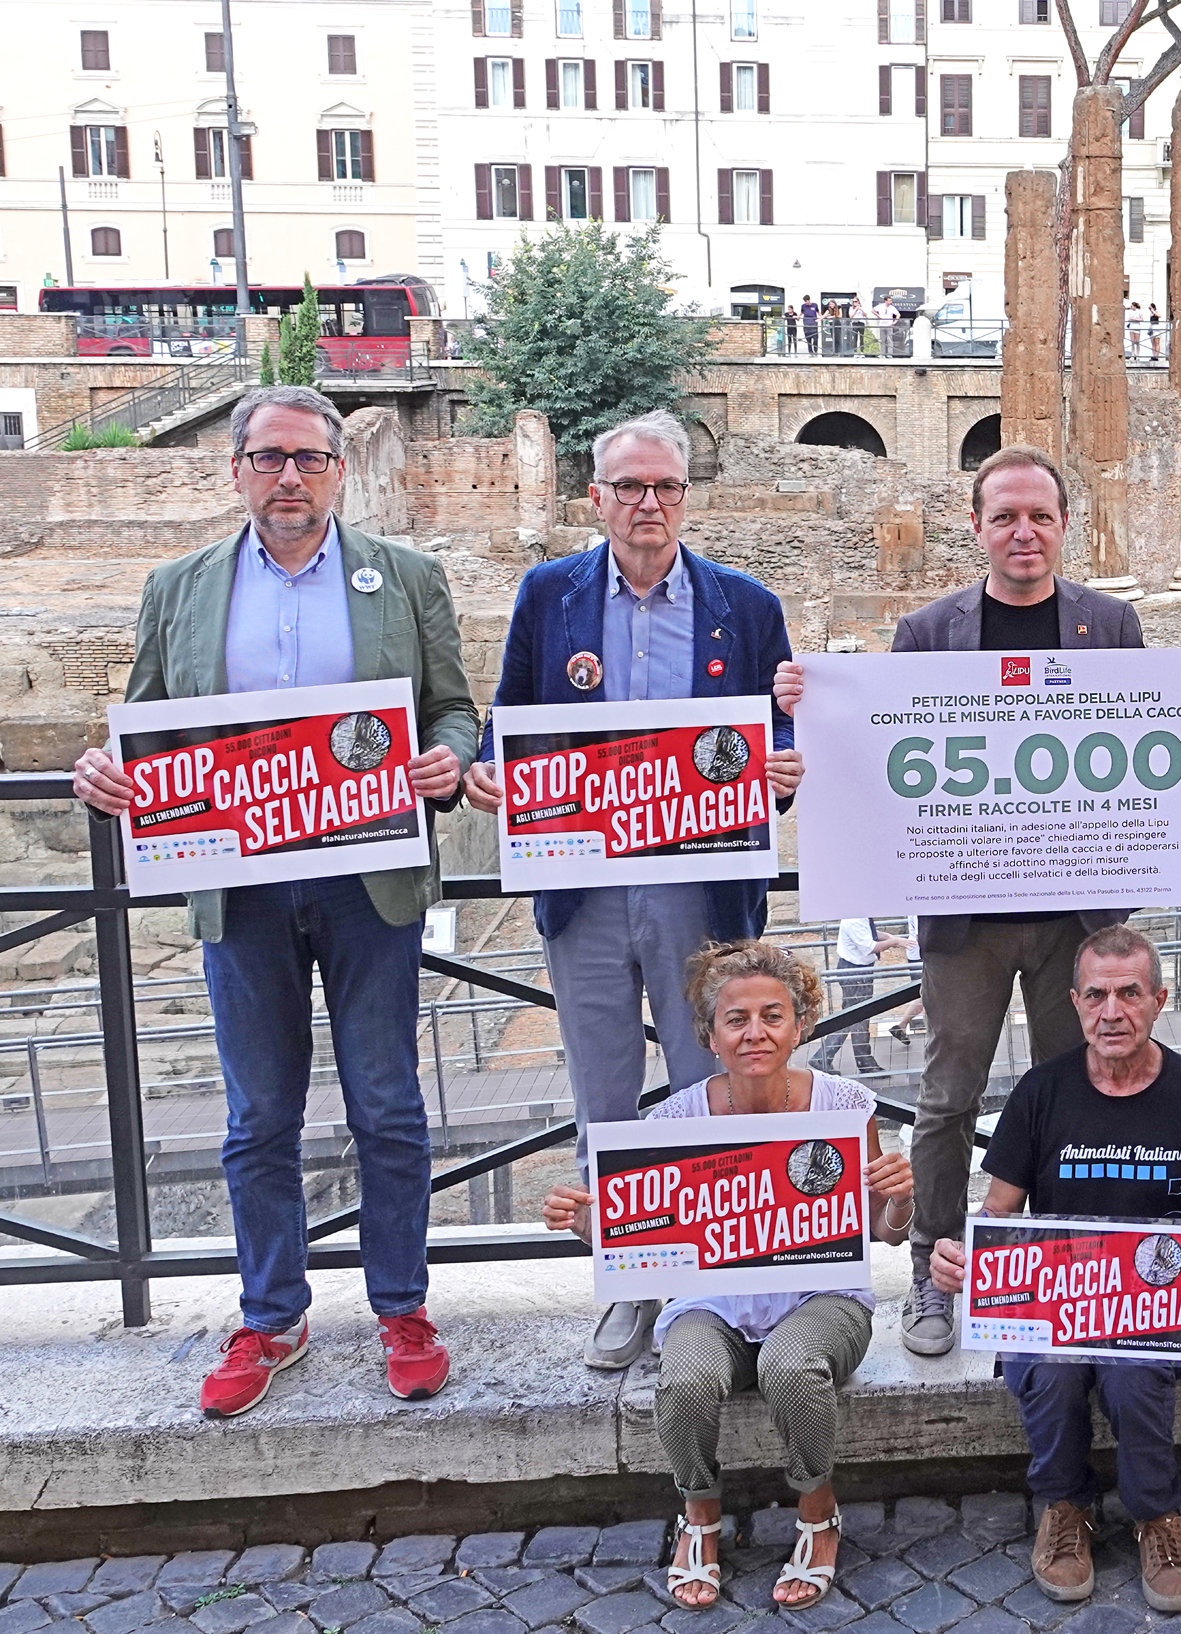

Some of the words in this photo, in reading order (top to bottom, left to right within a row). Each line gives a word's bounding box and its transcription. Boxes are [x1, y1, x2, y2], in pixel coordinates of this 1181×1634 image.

[912, 694, 990, 707] PETIZIONE
[994, 693, 1074, 705] POPOLARE
[1078, 692, 1125, 703] DELLA
[1129, 691, 1160, 702] LIPU
[870, 712, 934, 724] CONTRO
[939, 711, 956, 723] LE
[960, 710, 1015, 722] MISURE
[1019, 710, 1030, 721] A
[1034, 708, 1091, 720] FAVORE
[1096, 707, 1142, 719] DELLA
[133, 748, 214, 808] STOP
[214, 746, 319, 811] CACCIA
[513, 752, 587, 806] STOP
[585, 756, 681, 813] CACCIA
[140, 814, 155, 826] AGLI
[157, 802, 206, 822] EMENDAMENTI
[245, 766, 412, 850] SELVAGGIA
[516, 813, 530, 824] AGLI
[532, 804, 576, 821] EMENDAMENTI
[611, 780, 765, 852] SELVAGGIA
[918, 803, 972, 817] FIRME
[978, 800, 1071, 815] RACCOLTE
[1077, 799, 1094, 812] IN
[1100, 798, 1111, 811] 4
[1117, 797, 1157, 810] MESI
[322, 827, 408, 843] #laNaturaNonSiTocca
[906, 826, 923, 834] Noi
[926, 825, 967, 834] cittadini
[971, 823, 1006, 832] italiani,
[1021, 822, 1065, 831] adesione
[1121, 819, 1144, 827] della
[1148, 819, 1168, 827] Lipu
[680, 840, 760, 850] #laNaturaNonSiTocca
[970, 835, 1001, 844] volare
[1047, 833, 1099, 842] chiediamo
[1101, 831, 1111, 840] di
[1114, 831, 1166, 840] respingere
[896, 850, 905, 858] le
[908, 849, 954, 859] proposte
[966, 848, 1008, 857] ulteriore
[1011, 846, 1042, 855] favore
[1045, 845, 1068, 854] della
[1071, 845, 1103, 853] caccia
[1114, 843, 1123, 851] di
[1126, 842, 1178, 851] adoperarsi
[949, 859, 989, 869] affinché
[1003, 858, 1045, 867] adottino
[1049, 857, 1092, 866] maggiori
[915, 873, 925, 882] di
[928, 872, 957, 881] tutela
[960, 871, 985, 881] degli
[988, 870, 1019, 879] uccelli
[1023, 869, 1062, 878] selvatici
[1074, 868, 1098, 876] della
[1101, 865, 1161, 875] biodiversità.
[1060, 1144, 1132, 1161] Animalisti
[606, 1166, 680, 1220] STOP
[678, 1169, 775, 1226] CACCIA
[610, 1227, 624, 1237] AGLI
[625, 1217, 670, 1234] EMENDAMENTI
[704, 1192, 859, 1264] SELVAGGIA
[773, 1251, 853, 1262] #laNaturaNonSiTocca
[976, 1246, 1042, 1291] STOP
[1038, 1257, 1122, 1303] CACCIA
